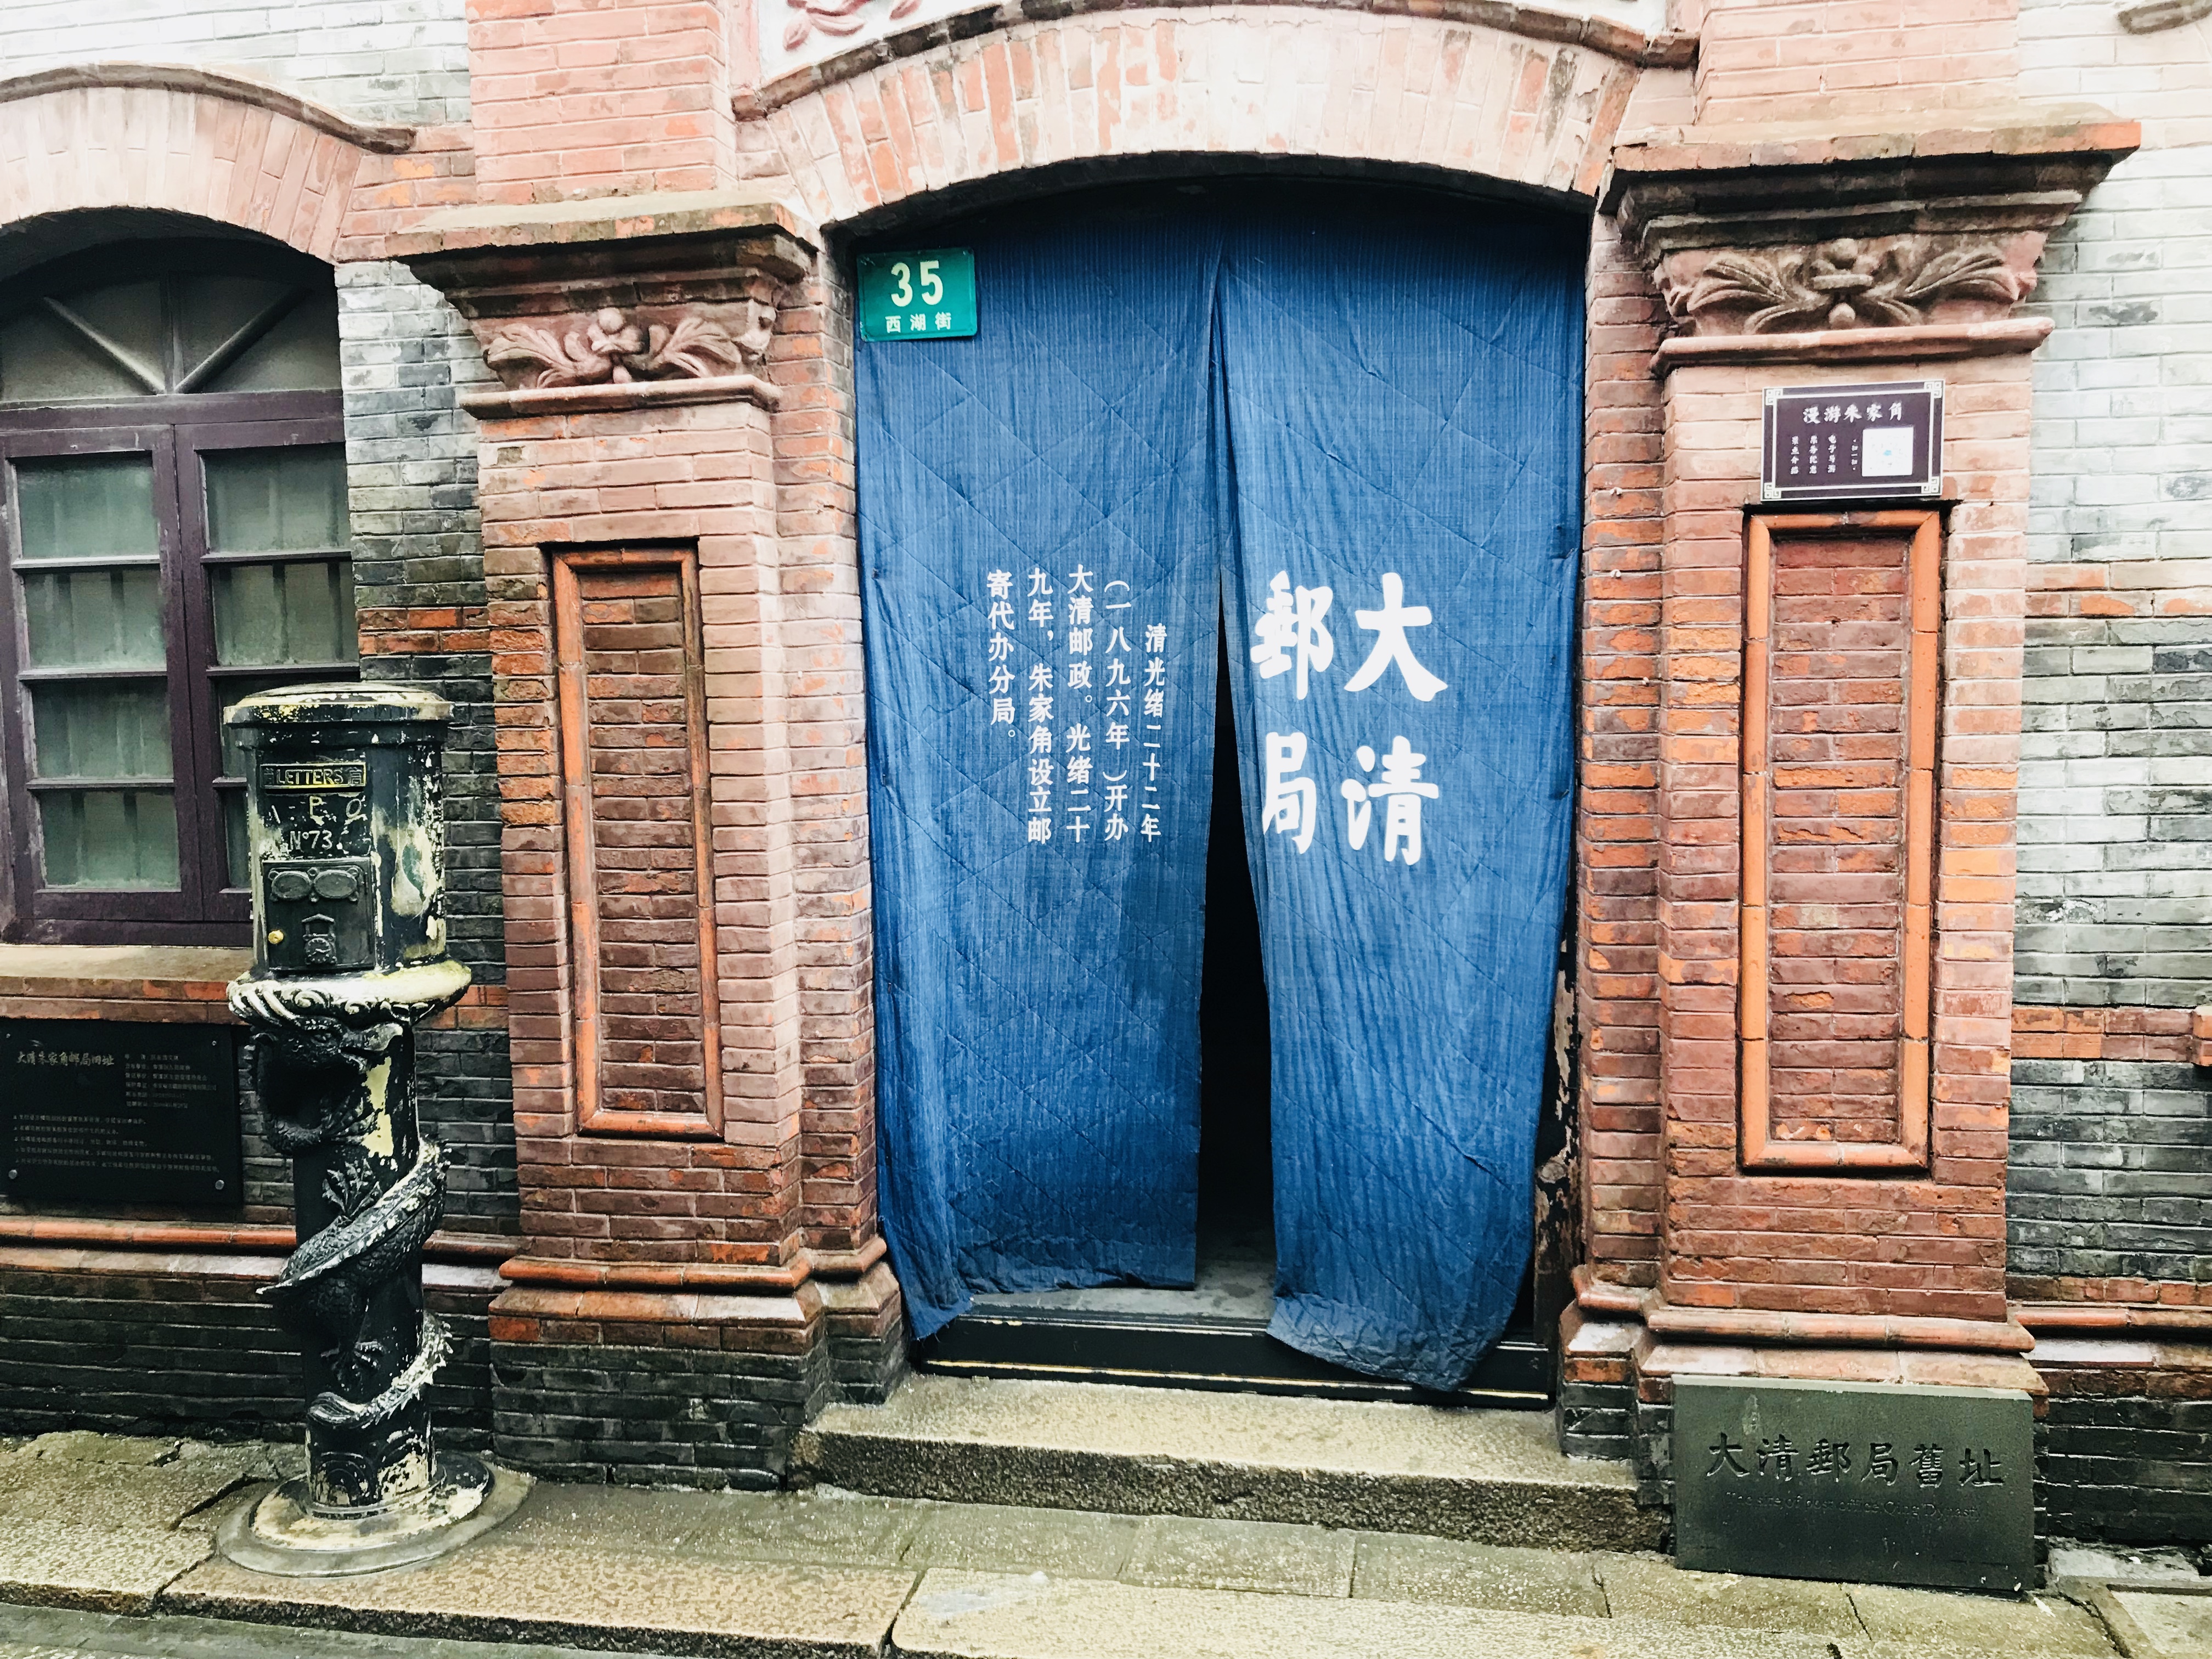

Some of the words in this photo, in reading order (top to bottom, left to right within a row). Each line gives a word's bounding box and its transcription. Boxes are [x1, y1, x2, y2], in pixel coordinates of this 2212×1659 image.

[891, 259, 943, 307] 35
[885, 312, 952, 334] 西湖街
[1802, 400, 1903, 424] 漫游朱家角
[1828, 435, 1836, 473] 电子导游
[986, 569, 1016, 738] 寄代办分局。
[1141, 624, 1167, 843] 清光绪二十二年
[1250, 570, 1334, 854] 郵局
[1341, 572, 1448, 866] 大清
[276, 769, 344, 785] LETTERS
[1706, 1432, 2005, 1488] 大清郵局舊址
[1785, 1494, 1803, 1509] of
